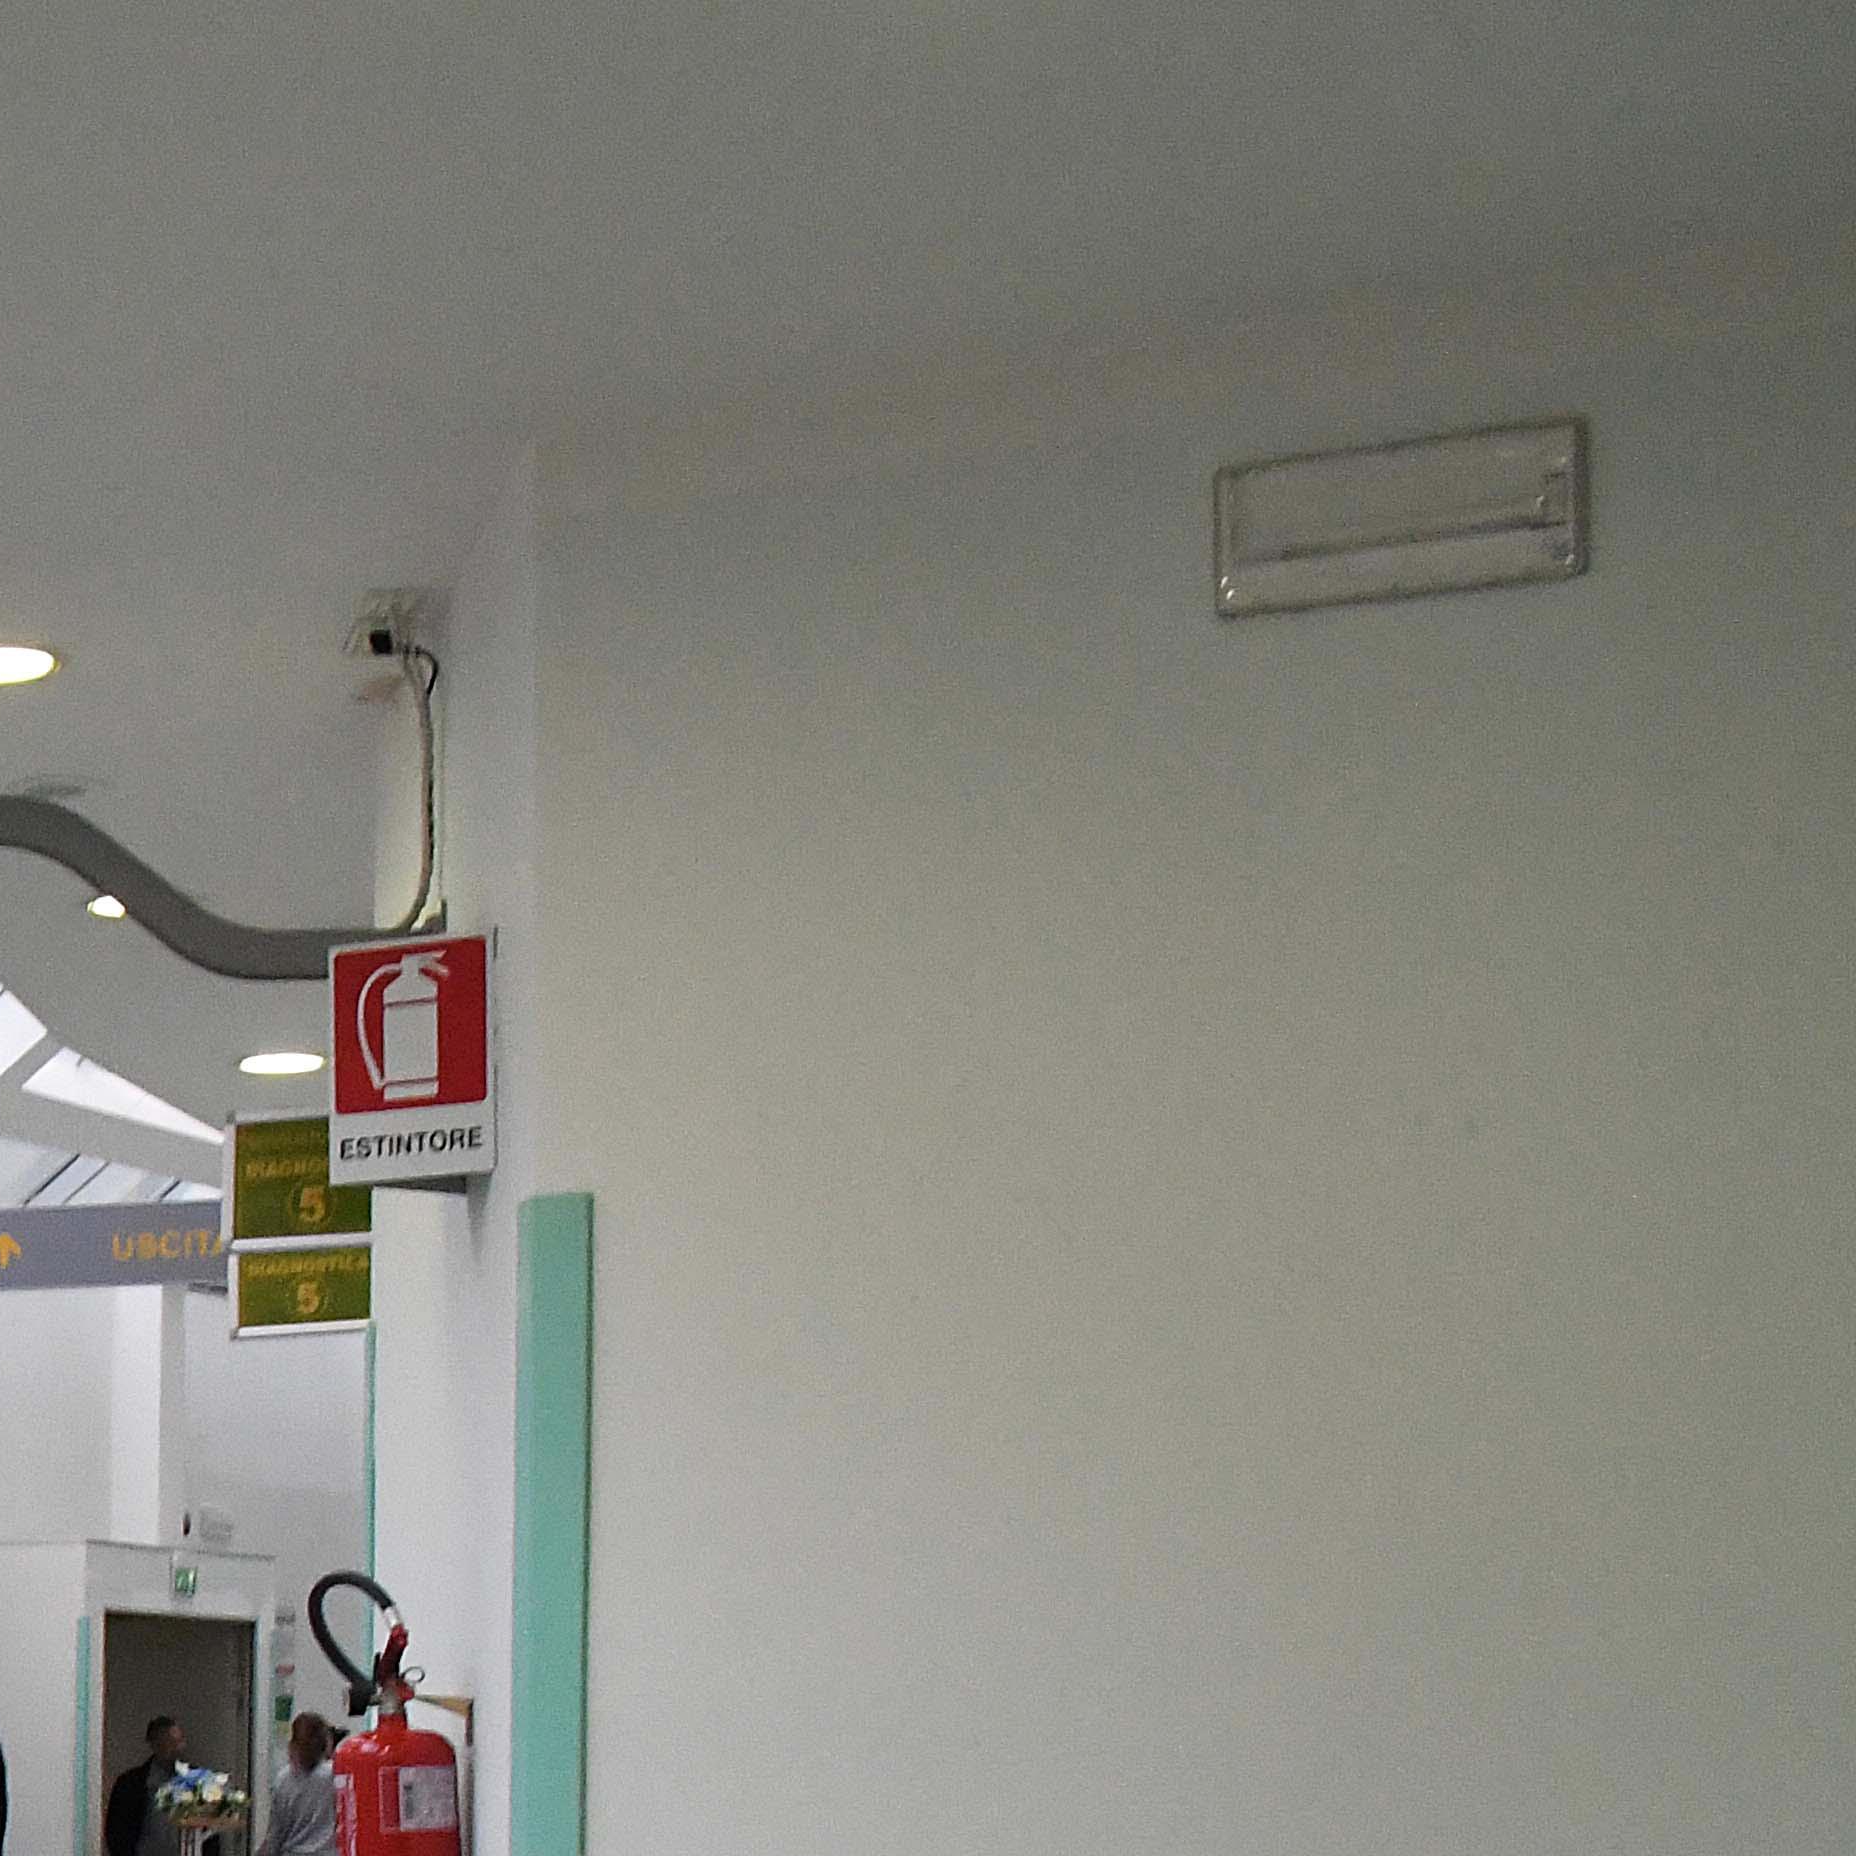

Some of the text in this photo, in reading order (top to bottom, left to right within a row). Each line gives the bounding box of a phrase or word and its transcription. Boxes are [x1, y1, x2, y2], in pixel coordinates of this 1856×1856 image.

[340, 1126, 484, 1160] ESTINTORE
[299, 1185, 326, 1222] 5
[296, 1282, 320, 1314] 5
